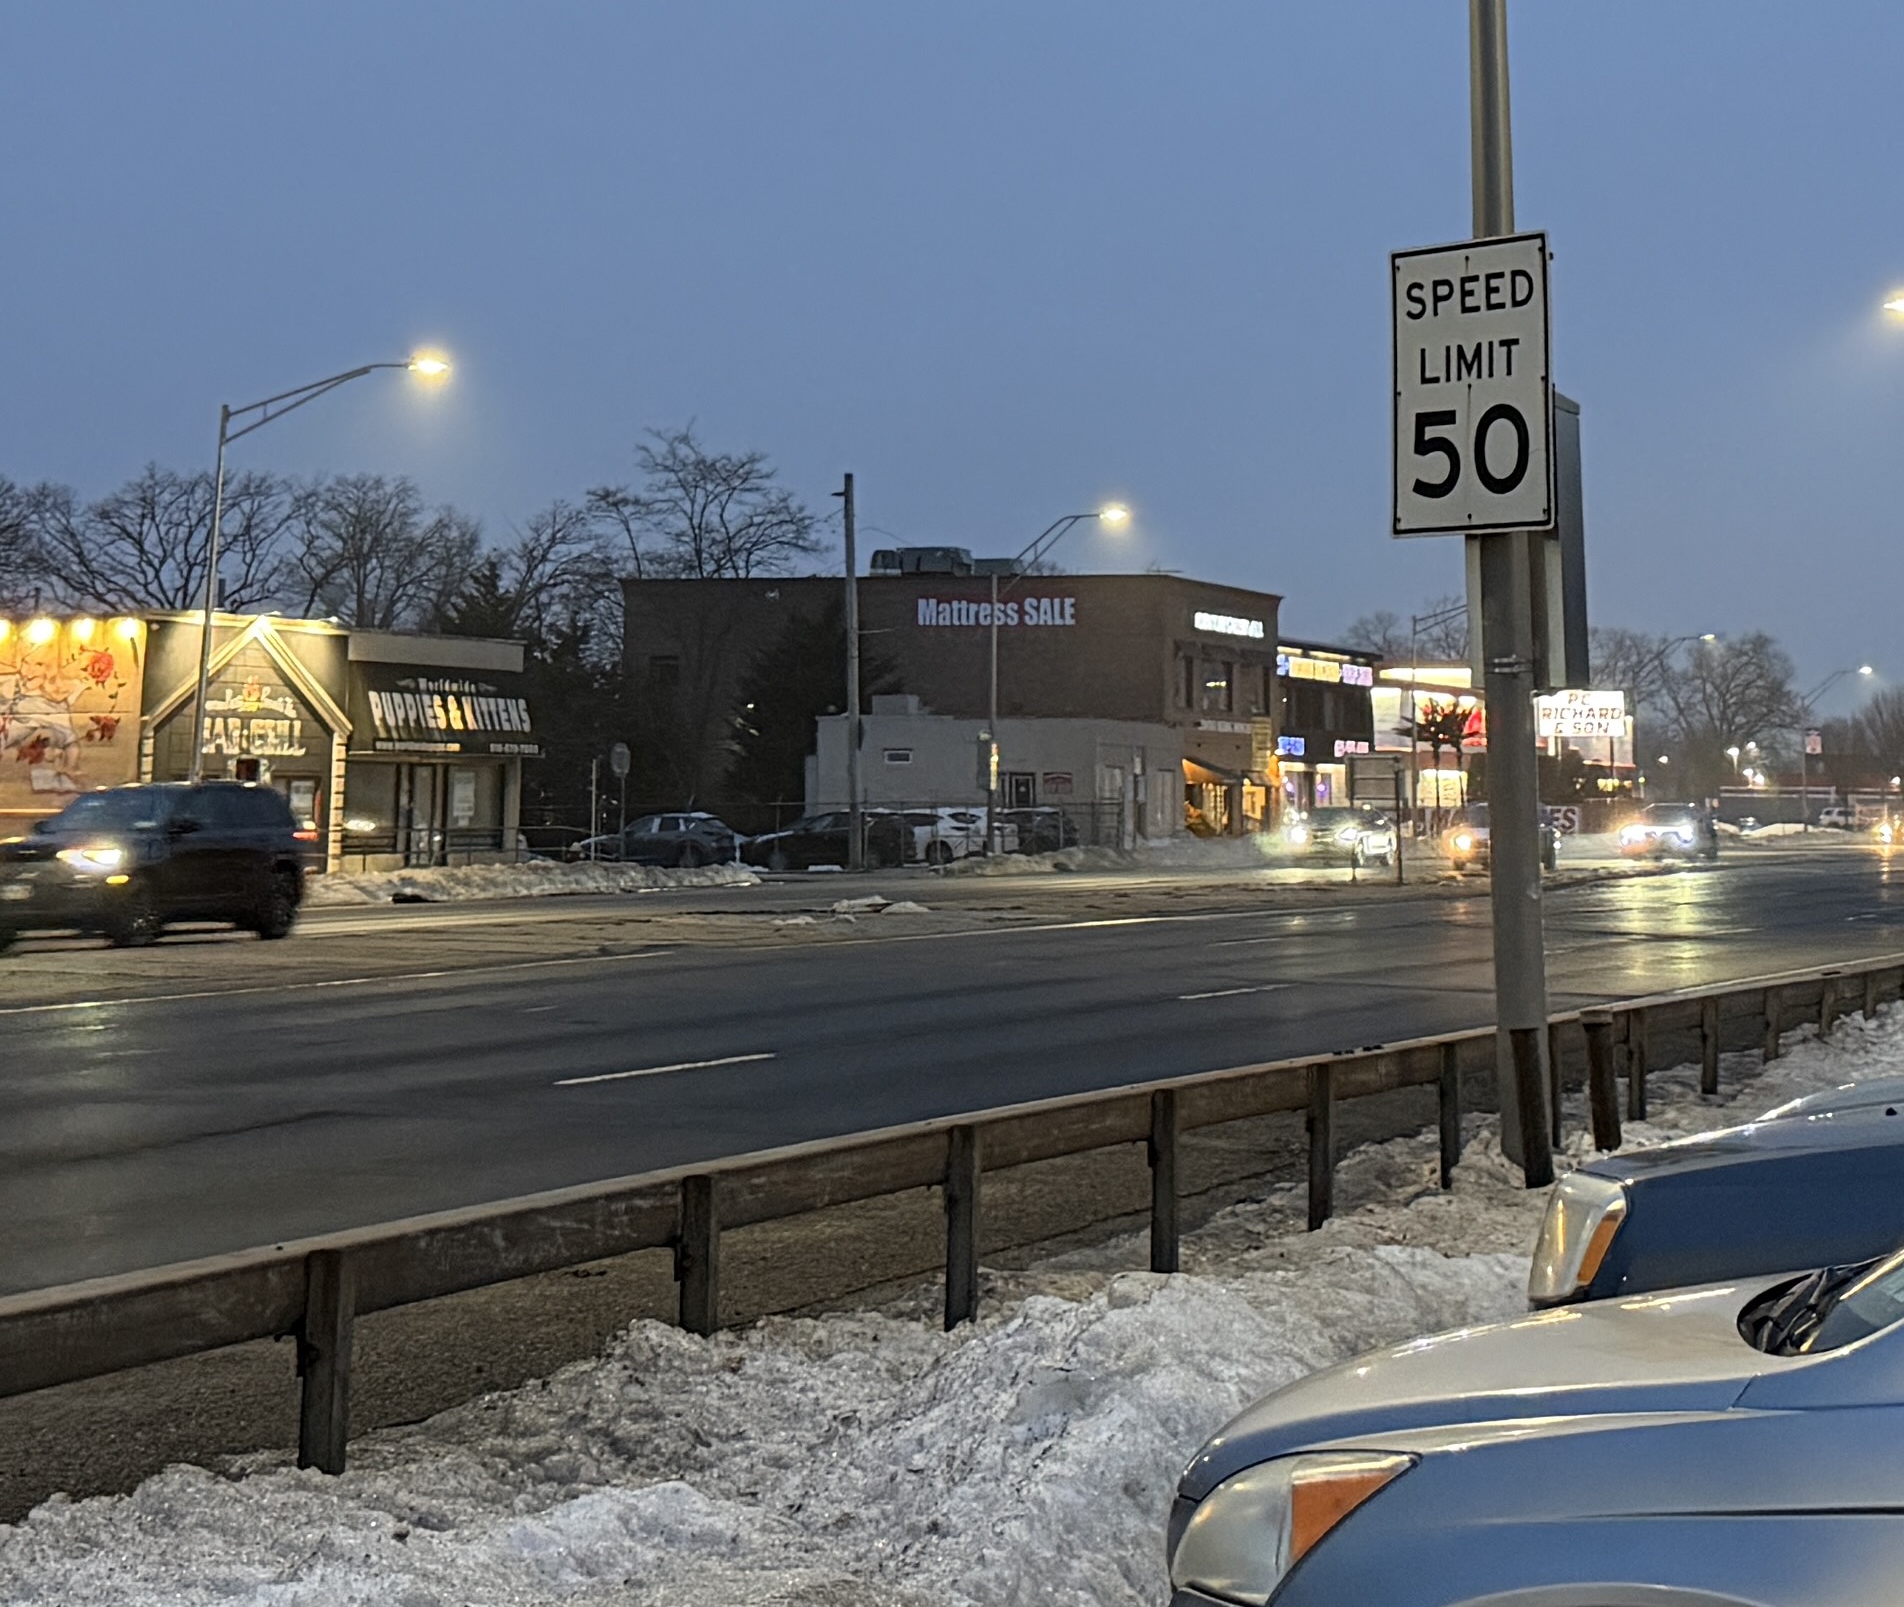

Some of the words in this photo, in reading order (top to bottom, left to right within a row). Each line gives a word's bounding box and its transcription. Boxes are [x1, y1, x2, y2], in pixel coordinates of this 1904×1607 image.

[1406, 269, 1534, 320] SPEED
[1420, 338, 1520, 385] LIMIT
[1412, 403, 1530, 499] 50
[917, 598, 1019, 626] Mattress
[1024, 597, 1076, 626] SALE
[368, 691, 447, 730] PUPPIES
[447, 695, 465, 730] &
[461, 696, 532, 733] KITTENS
[1542, 707, 1623, 720] RICHARD
[1568, 693, 1591, 706] PC
[1572, 722, 1610, 734] SON
